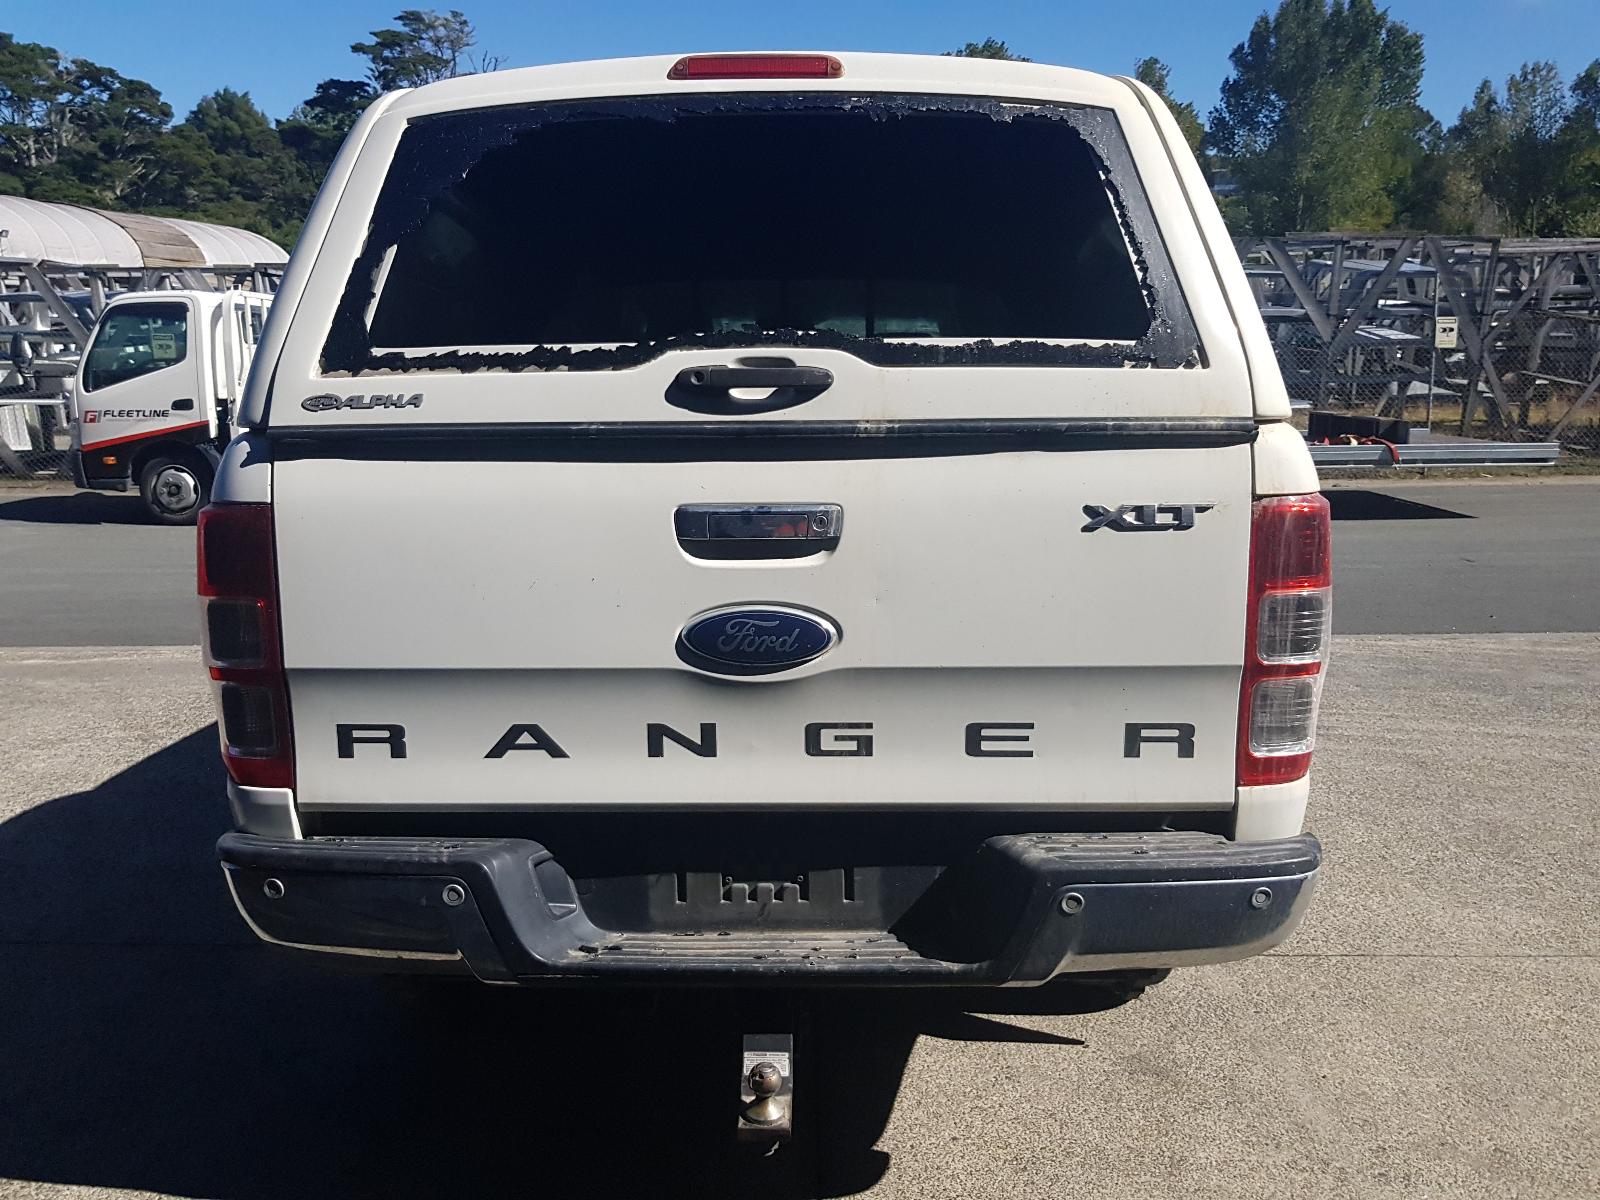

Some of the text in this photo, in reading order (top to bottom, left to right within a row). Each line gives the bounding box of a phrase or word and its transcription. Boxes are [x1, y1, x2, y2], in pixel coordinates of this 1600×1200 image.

[103, 409, 170, 418] FLEETLINE
[342, 393, 424, 410] ALPHA
[1080, 504, 1216, 533] XLT
[717, 618, 799, 653] Ford
[336, 722, 1196, 759] RANGER
